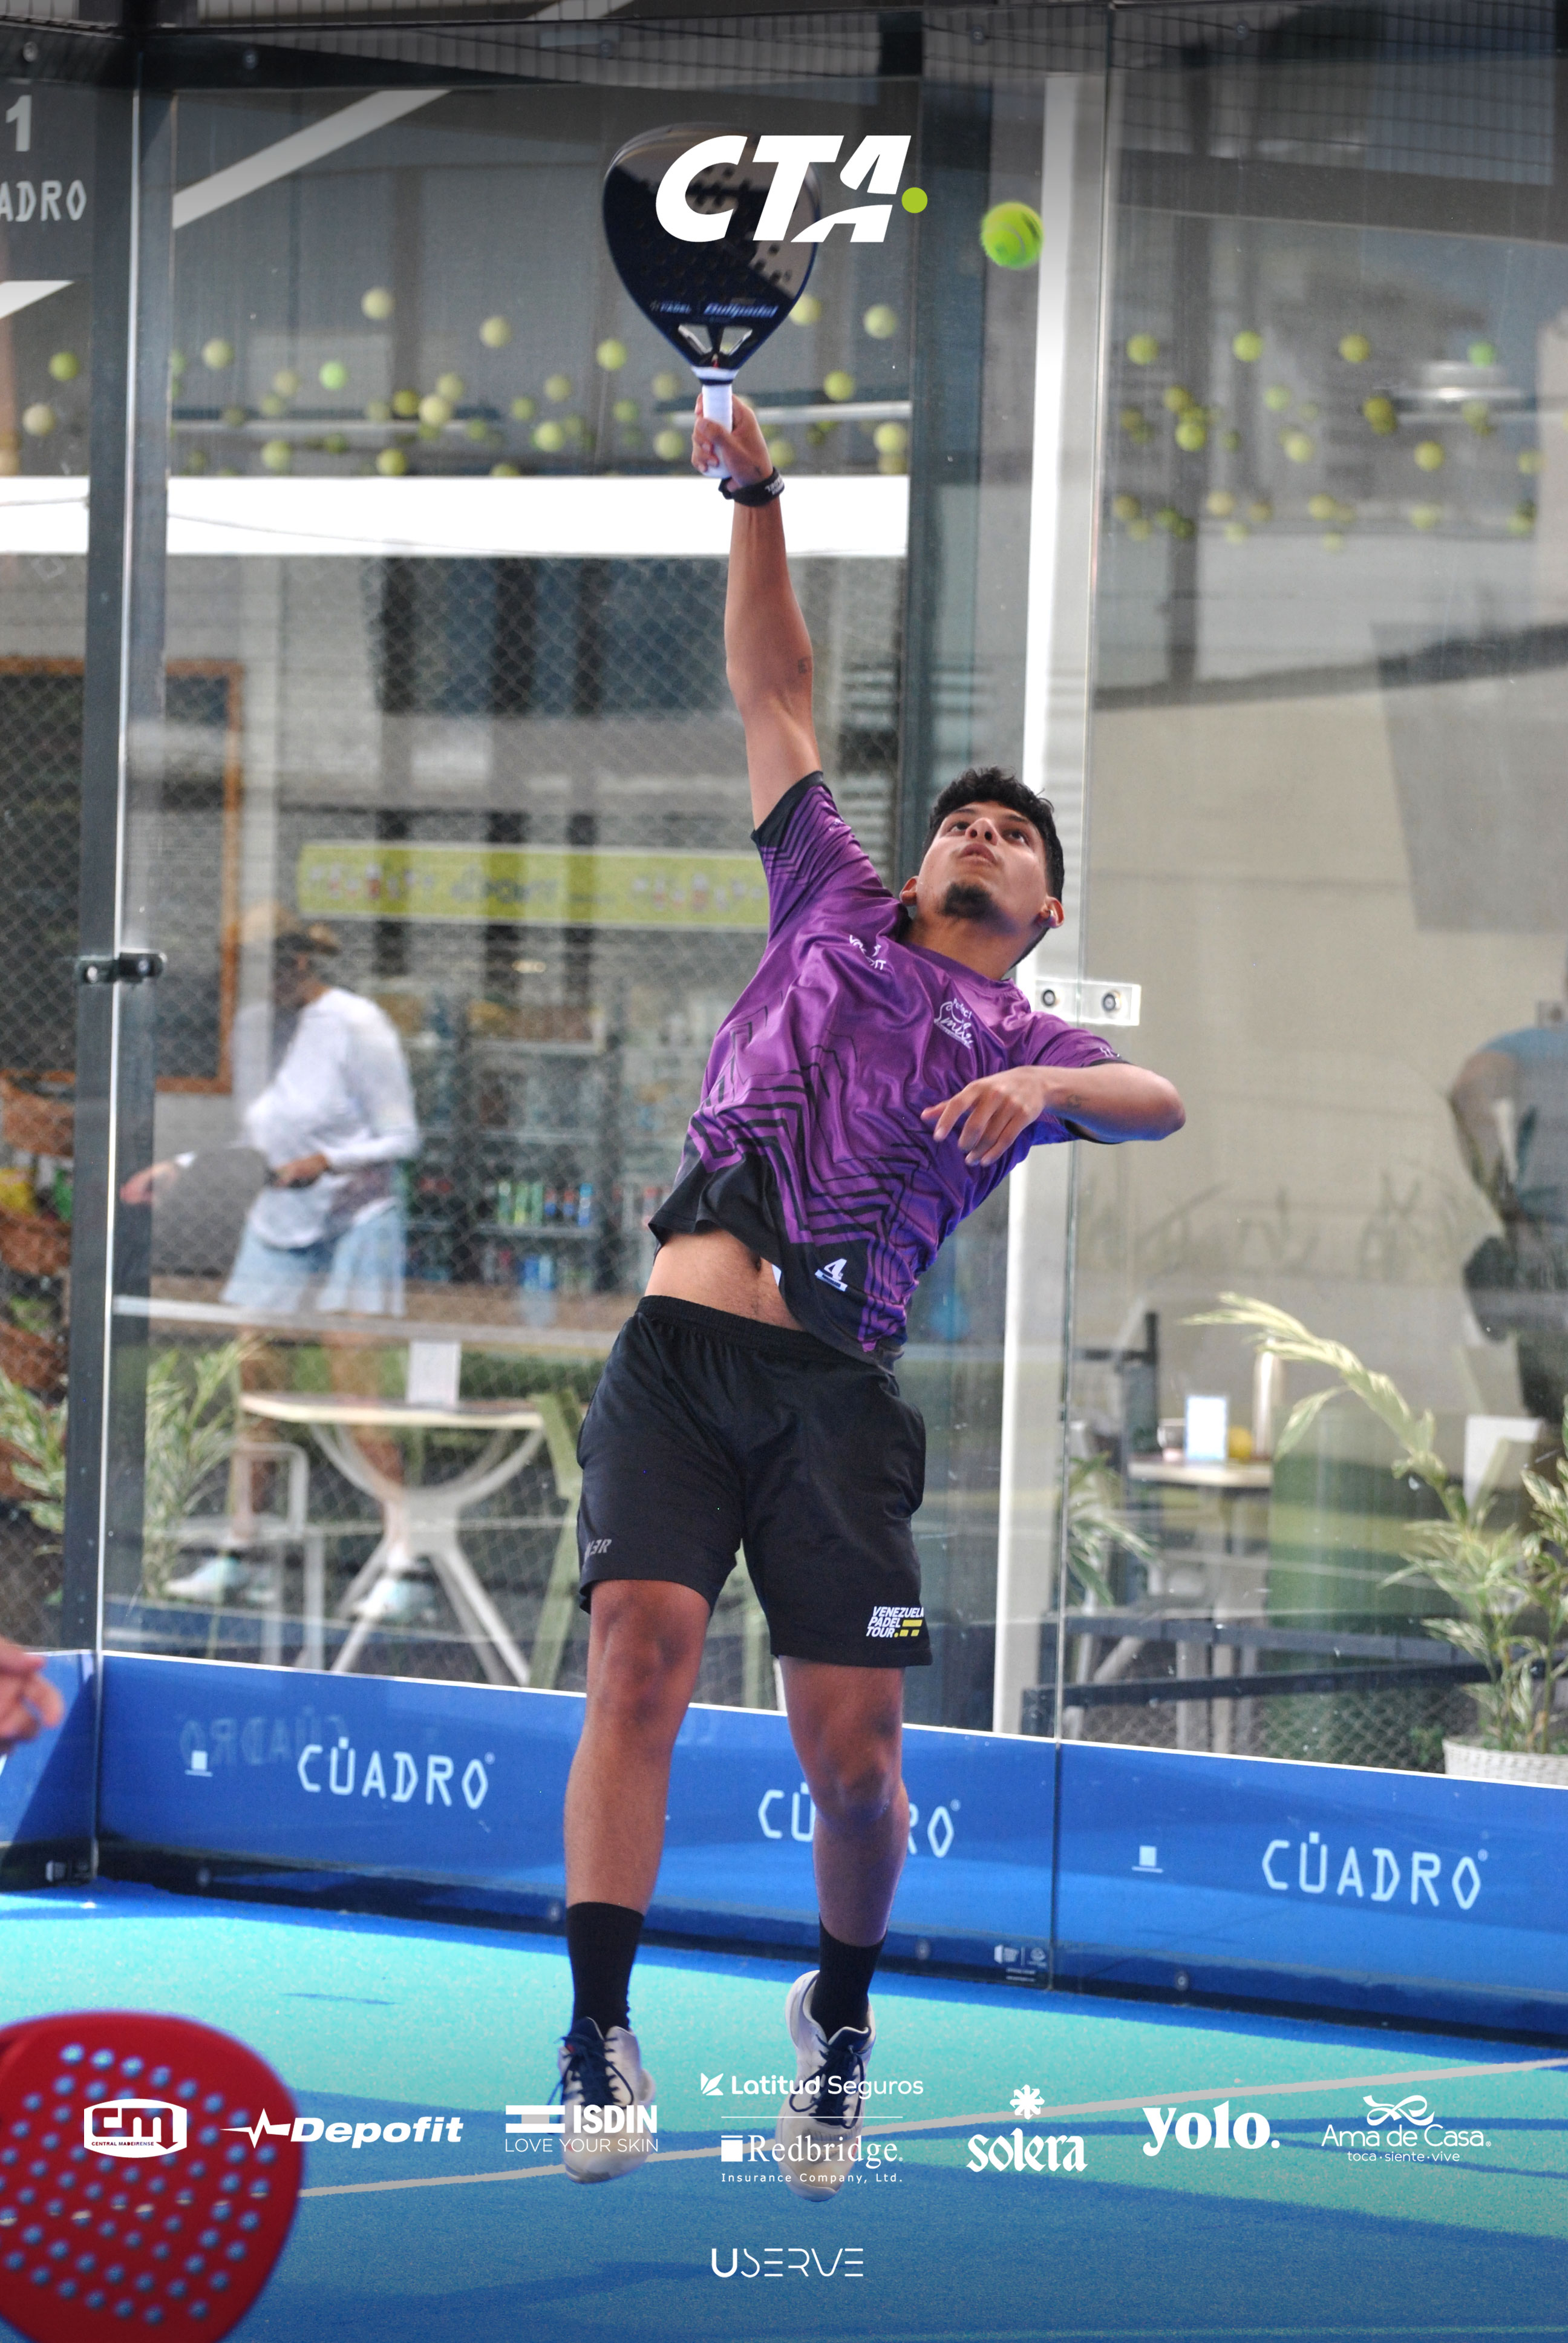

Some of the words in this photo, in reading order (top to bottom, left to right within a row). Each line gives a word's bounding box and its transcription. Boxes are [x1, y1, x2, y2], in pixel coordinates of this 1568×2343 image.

[5, 94, 31, 151] 1
[873, 1606, 924, 1618] VENEZUELA
[868, 1616, 901, 1628] PADEL
